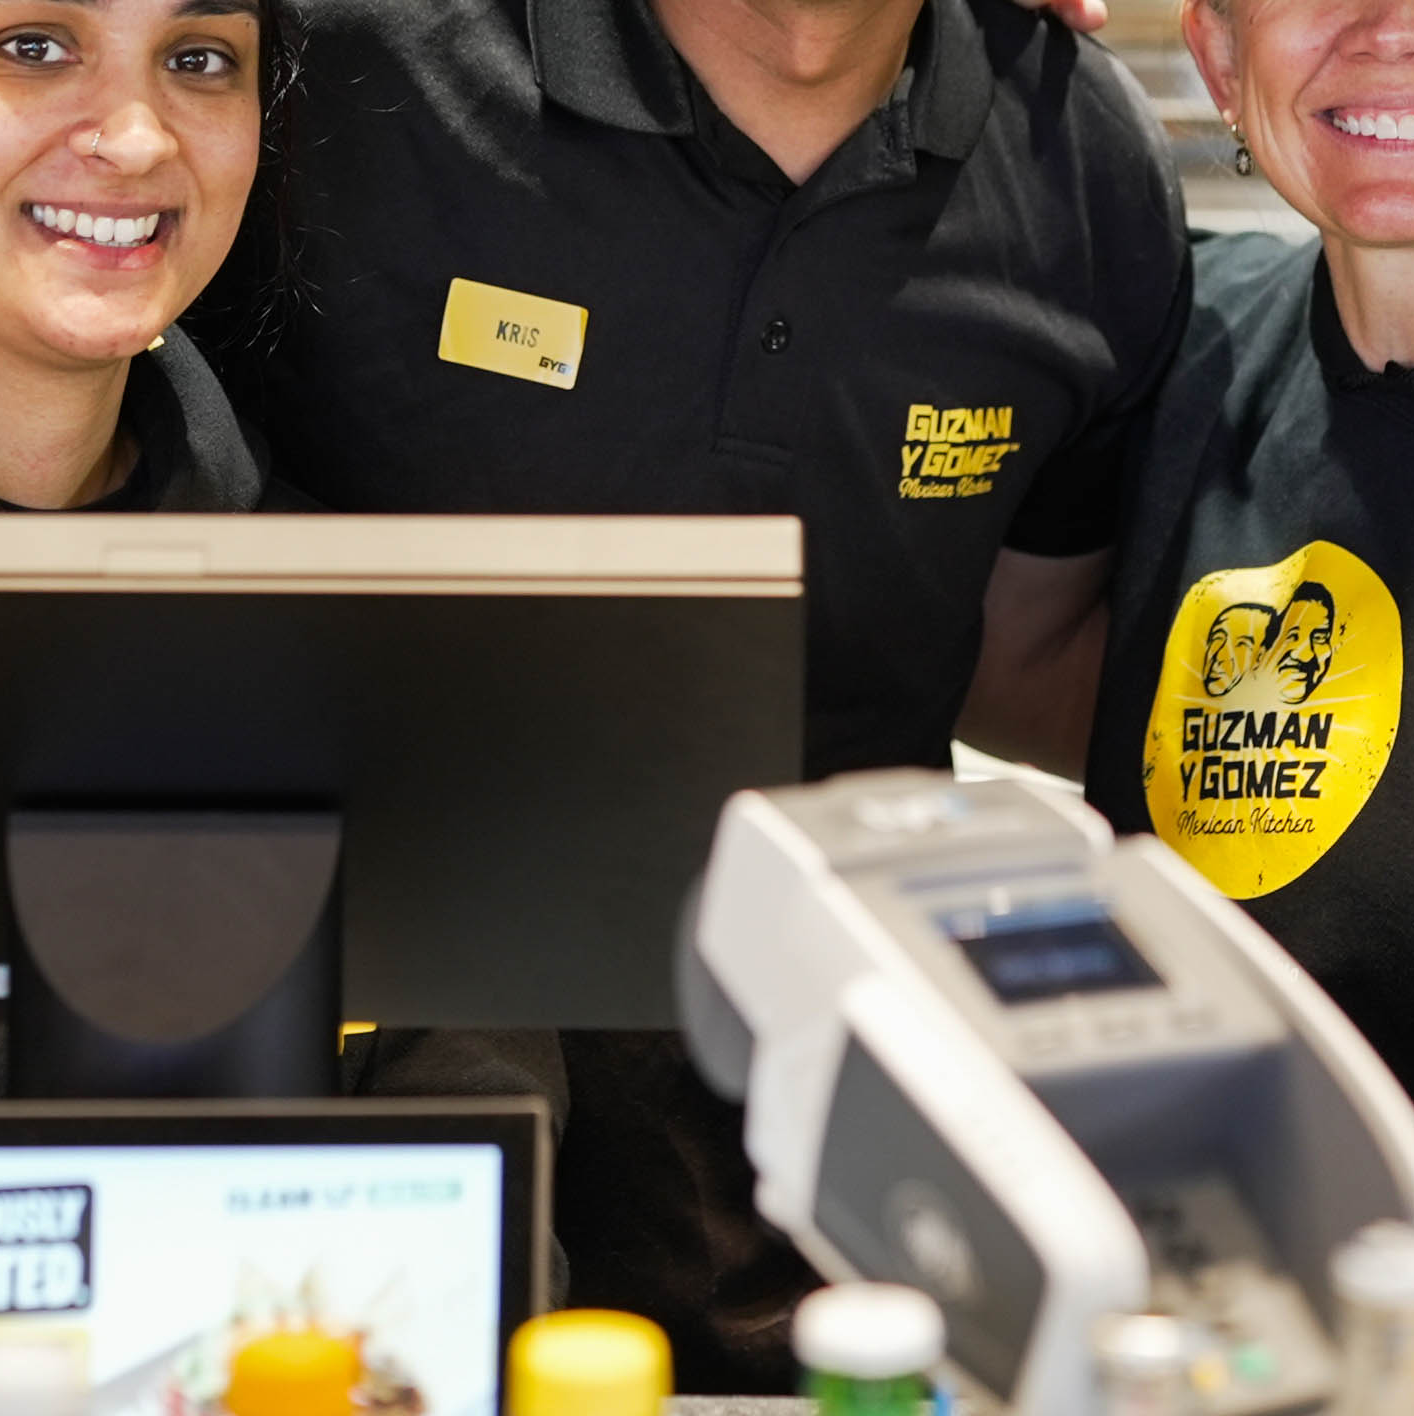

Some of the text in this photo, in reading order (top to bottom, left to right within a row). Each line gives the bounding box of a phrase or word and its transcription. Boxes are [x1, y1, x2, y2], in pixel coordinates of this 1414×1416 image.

[496, 319, 540, 349] KRIS
[538, 356, 570, 374] GYG
[905, 404, 1013, 443] GUZMAN
[901, 444, 924, 478] Y
[1182, 708, 1335, 753] GUZMAN
[1179, 755, 1328, 803] Y GOMEZ
[1176, 806, 1316, 836] Mexican Kitchen
